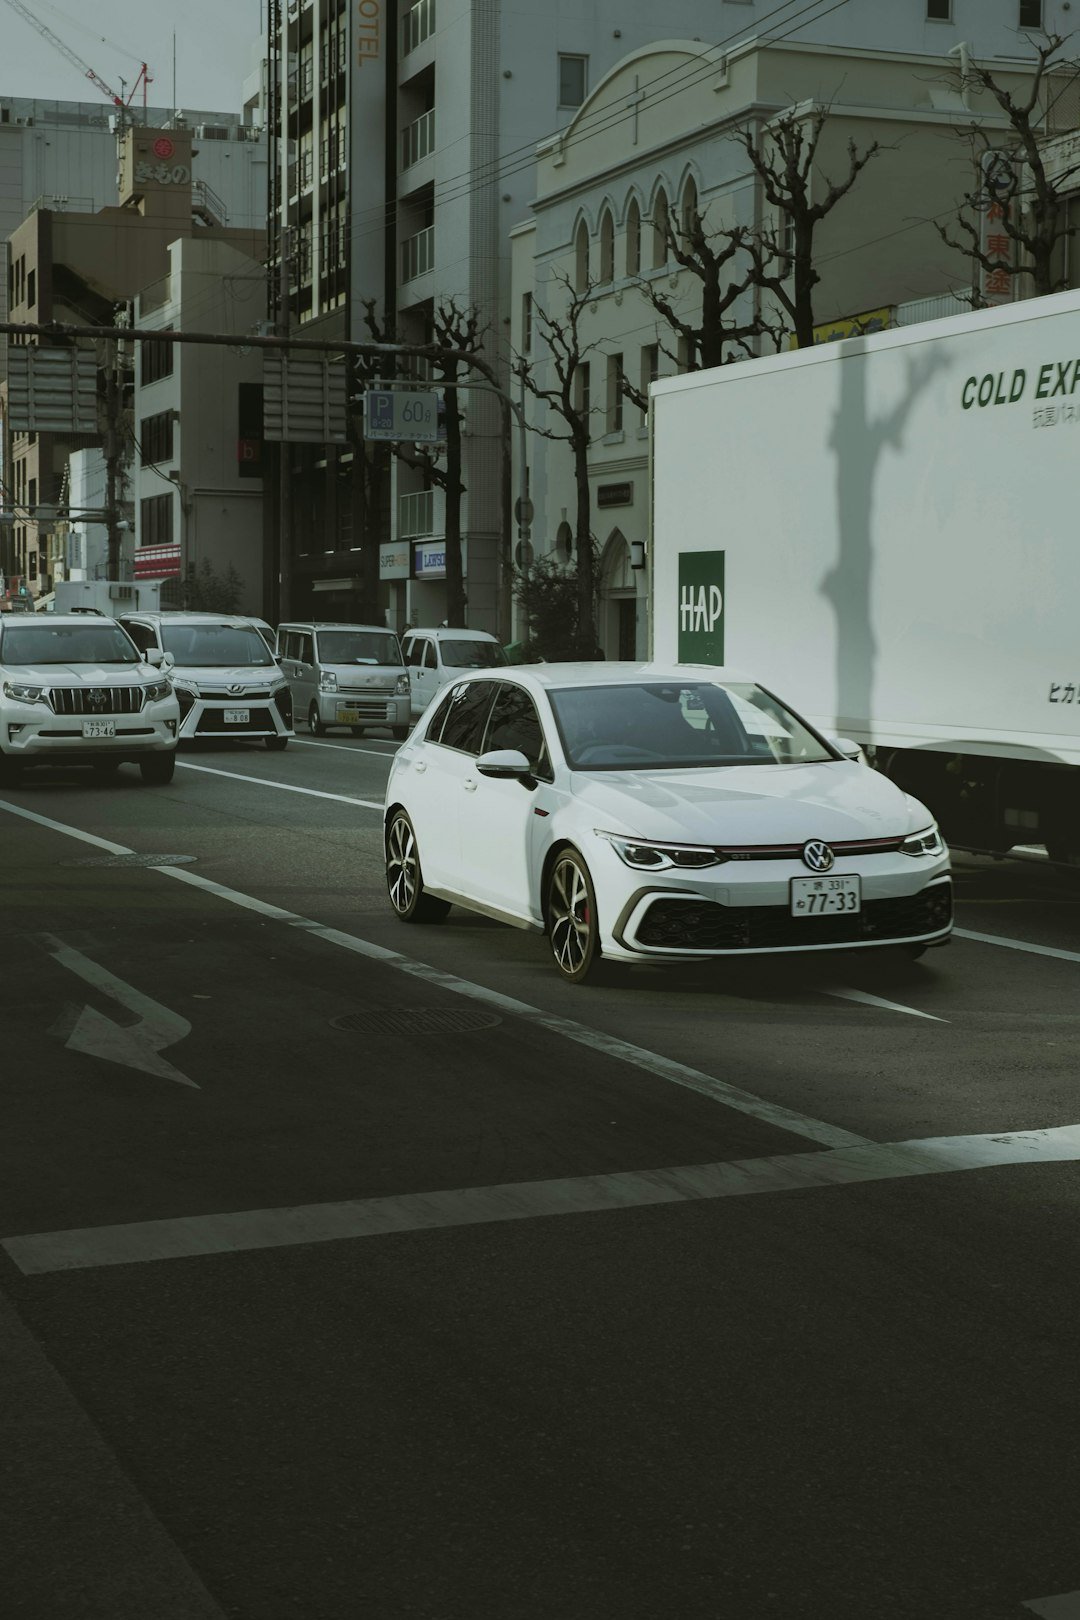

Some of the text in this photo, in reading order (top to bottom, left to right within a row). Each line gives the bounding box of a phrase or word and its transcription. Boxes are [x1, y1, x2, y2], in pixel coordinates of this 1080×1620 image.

[134, 161, 190, 184] きもの
[962, 368, 1026, 410] COLD
[680, 585, 722, 632] HAP
[90, 727, 114, 737] 73-46
[807, 891, 857, 913] 77-33
